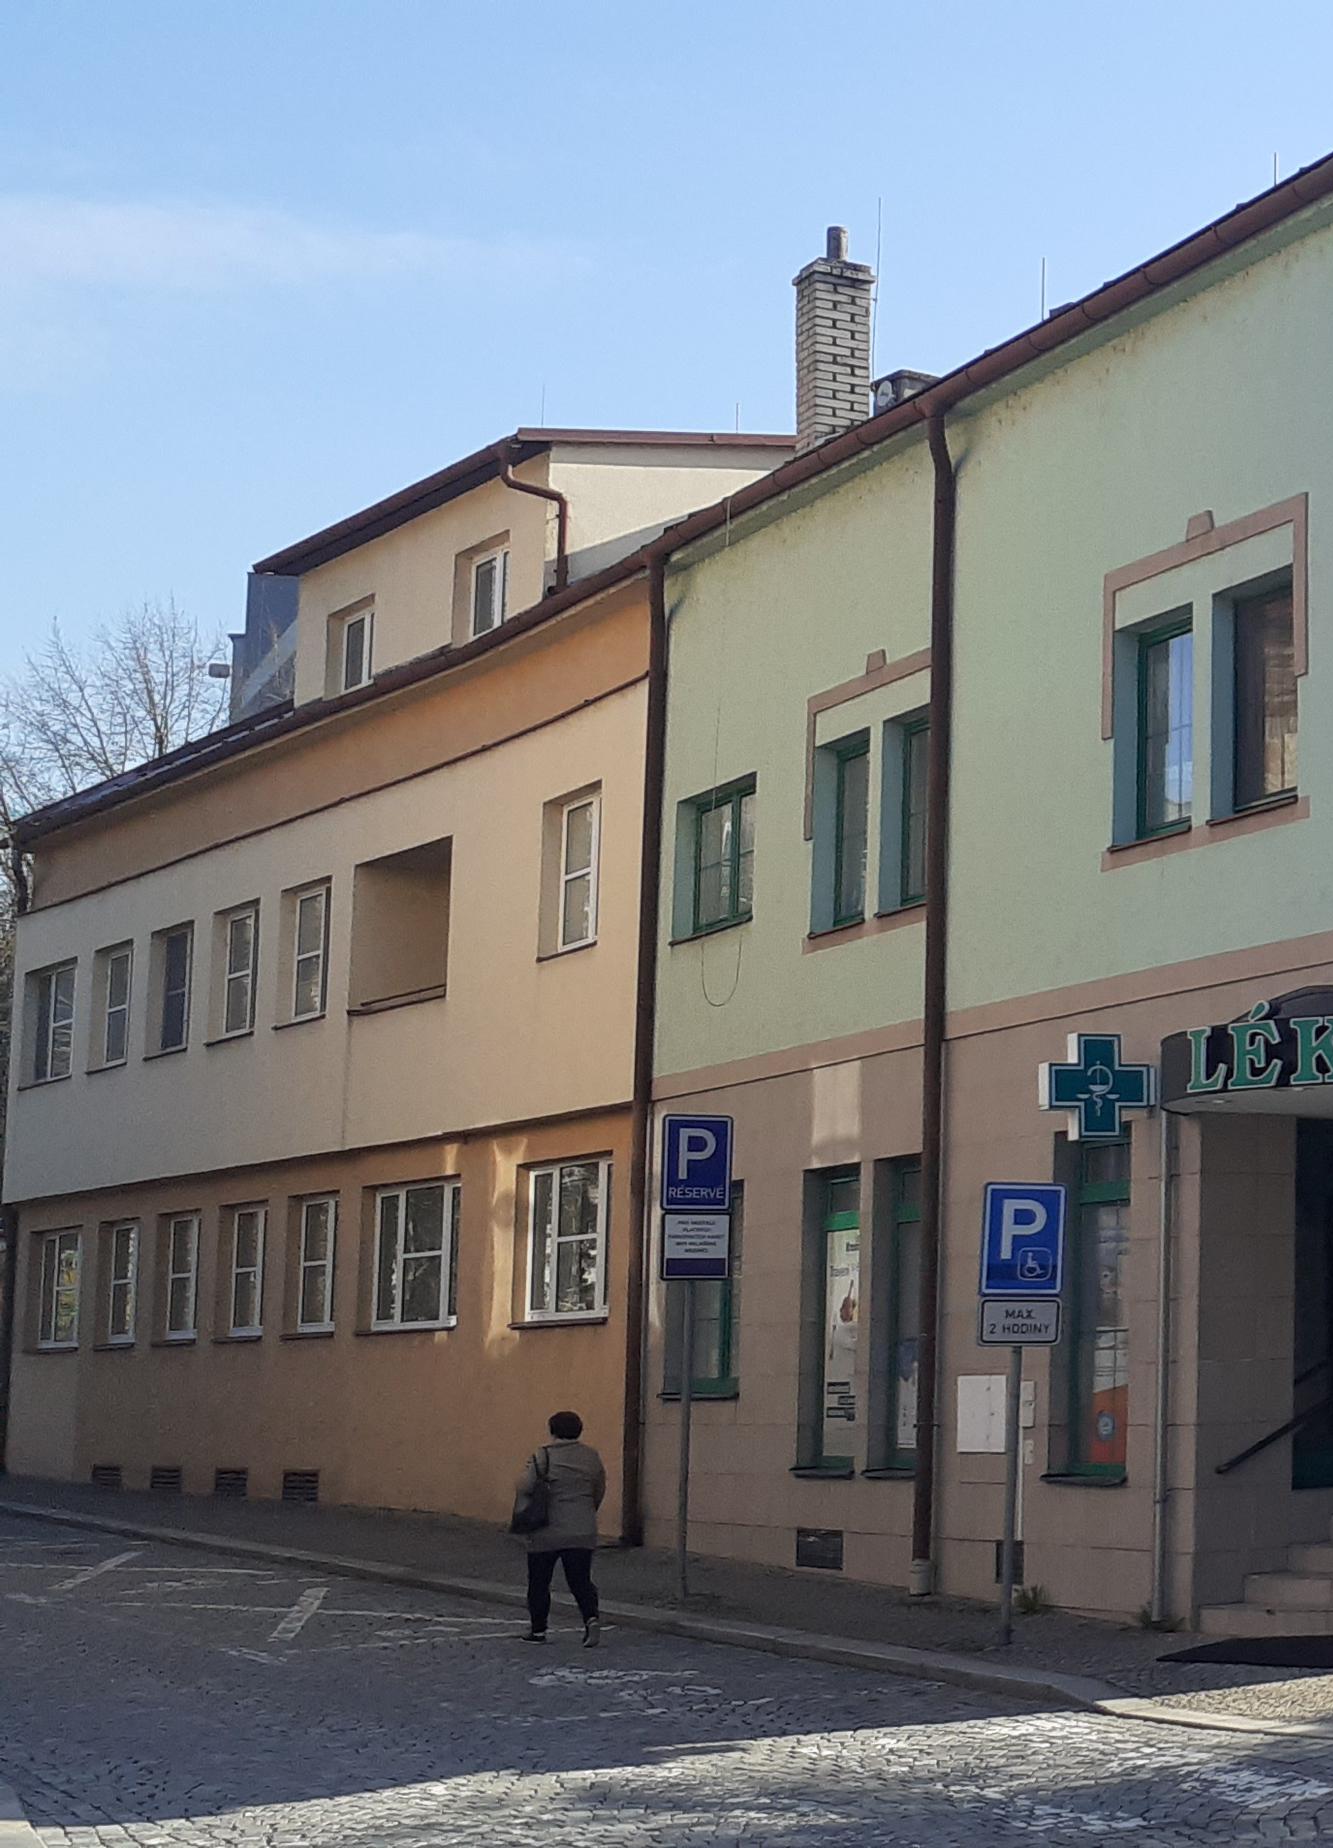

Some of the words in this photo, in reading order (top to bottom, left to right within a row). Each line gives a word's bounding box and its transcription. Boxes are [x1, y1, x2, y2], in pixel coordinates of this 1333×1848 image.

[677, 1128, 717, 1180] P
[668, 1185, 724, 1199] RÉSERVÉ
[1001, 1199, 1048, 1260] P
[989, 1323, 997, 1335] 2
[1002, 1323, 1050, 1335] HODINY
